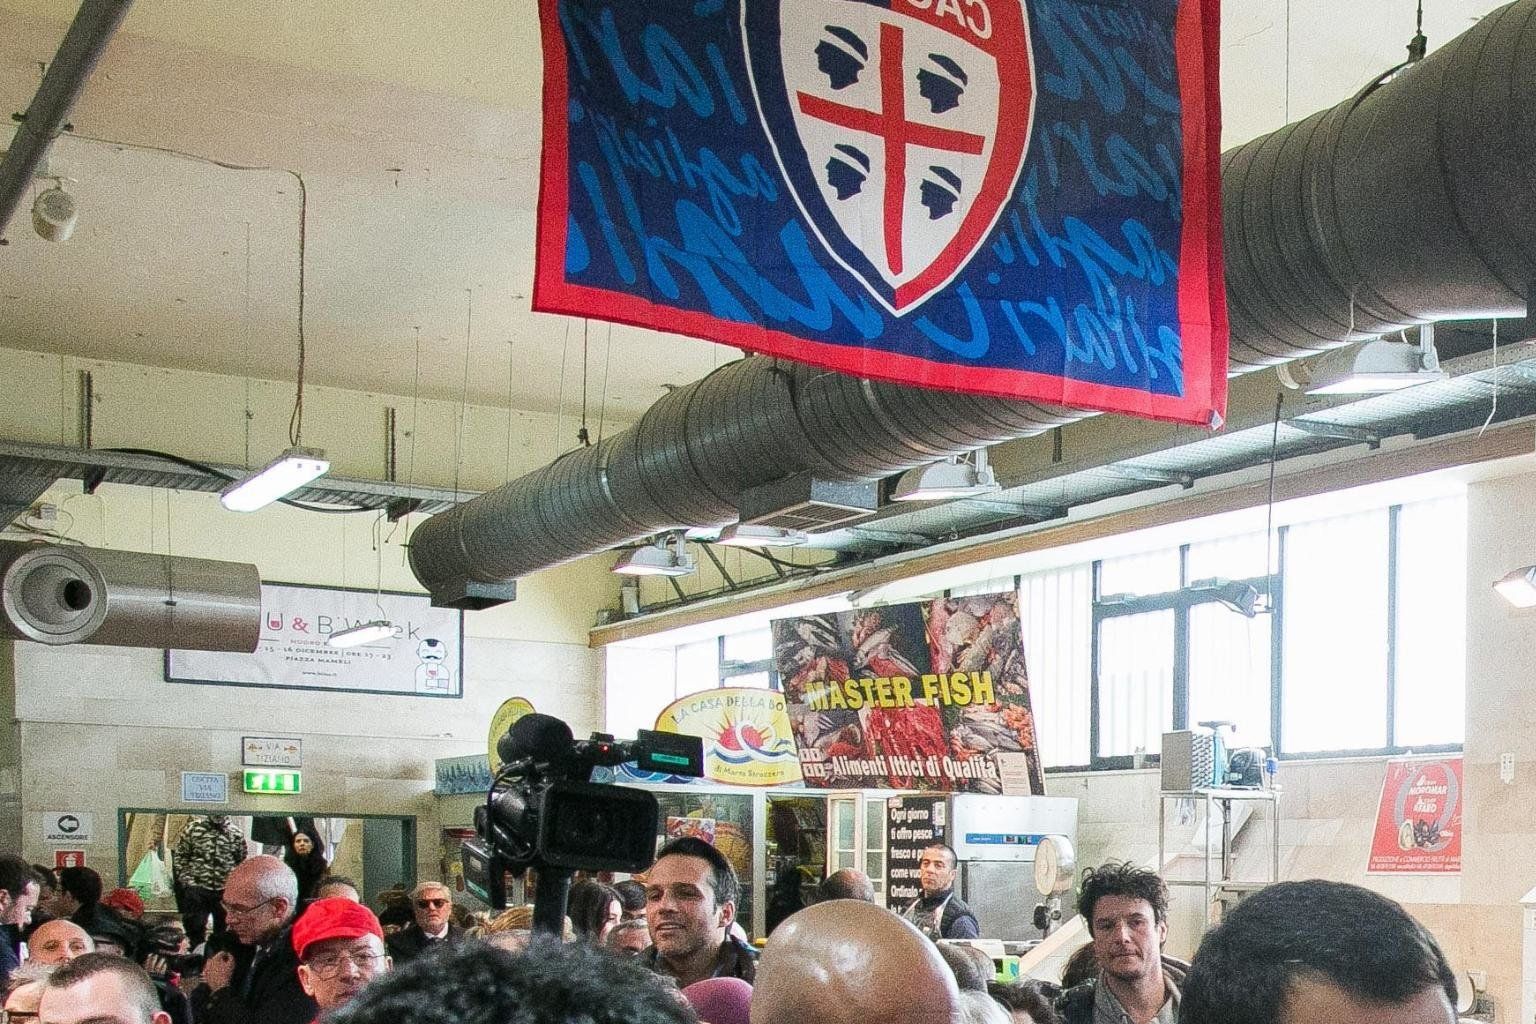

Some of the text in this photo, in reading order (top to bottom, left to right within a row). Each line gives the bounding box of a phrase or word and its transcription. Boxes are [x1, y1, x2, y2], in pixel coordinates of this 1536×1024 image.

[804, 671, 997, 711] MASTER FISH
[690, 697, 723, 714] CASA
[726, 695, 766, 709] DELLA
[266, 742, 281, 751] VIA
[833, 754, 888, 777] Alimenti
[889, 754, 924, 777] Ittici
[925, 754, 941, 777] di
[890, 808, 929, 824] Ogni giorno
[890, 828, 933, 843] ti offro pesce
[890, 846, 911, 859] fresco
[890, 869, 909, 878] come
